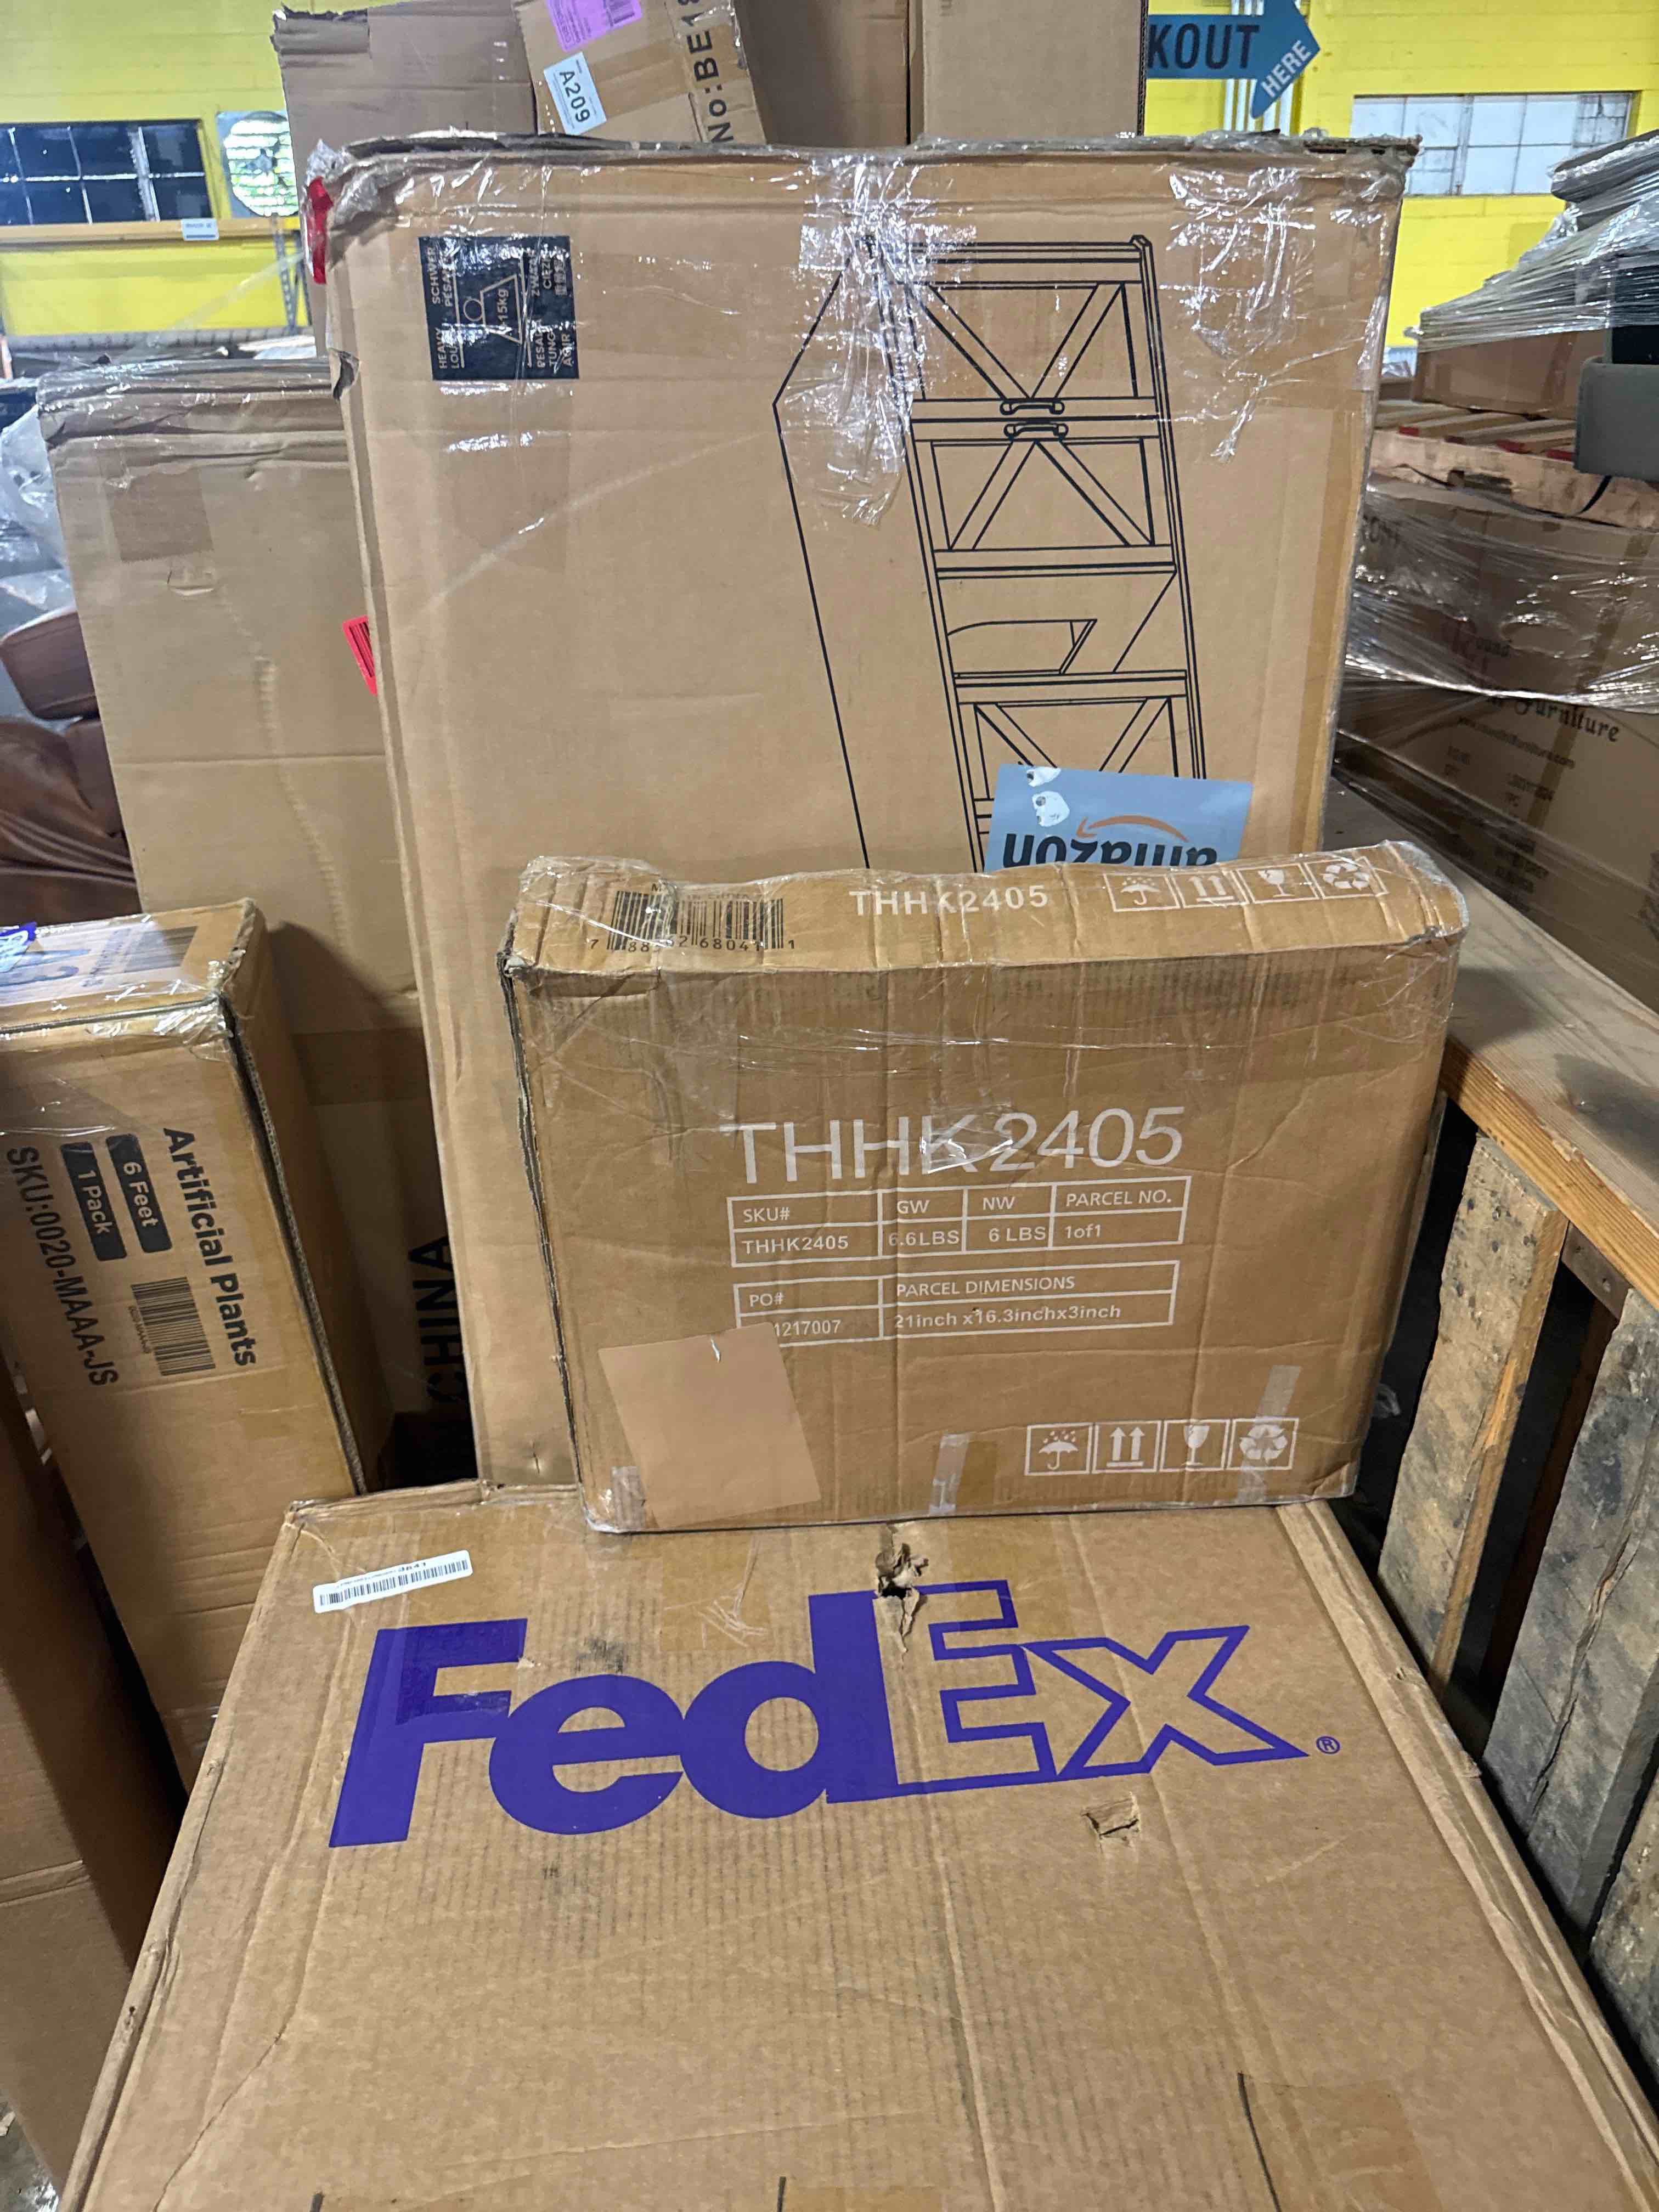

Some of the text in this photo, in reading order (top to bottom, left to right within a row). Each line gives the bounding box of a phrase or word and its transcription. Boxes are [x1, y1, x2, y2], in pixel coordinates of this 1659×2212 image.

[1262, 40, 1311, 98] HERE
[559, 71, 590, 123] A209
[427, 247, 441, 304] SCHWER
[547, 330, 558, 366] TUNG
[1002, 833, 1217, 868] amazon
[849, 885, 1049, 916] THHK2405
[590, 939, 599, 949] 7
[788, 940, 795, 949] 1
[719, 1106, 1185, 1184] THHK2405
[76, 1170, 115, 1234] 1 Pack
[123, 1161, 159, 1227] 6 Feet
[896, 1200, 930, 1214] GW
[983, 1196, 1015, 1211] NW
[1066, 1189, 1172, 1207] PARCEL NO.
[743, 1206, 791, 1223] SKU#
[163, 1127, 257, 1366] Artificial Plants
[742, 1235, 849, 1255] THHK2405
[989, 1226, 1046, 1242] 6 LBS
[1065, 1224, 1102, 1239] 1of1
[749, 1292, 784, 1307] PO#
[896, 1276, 1075, 1297] PARCEL DIMENSIONS
[329, 1579, 1309, 1849] FedEx
